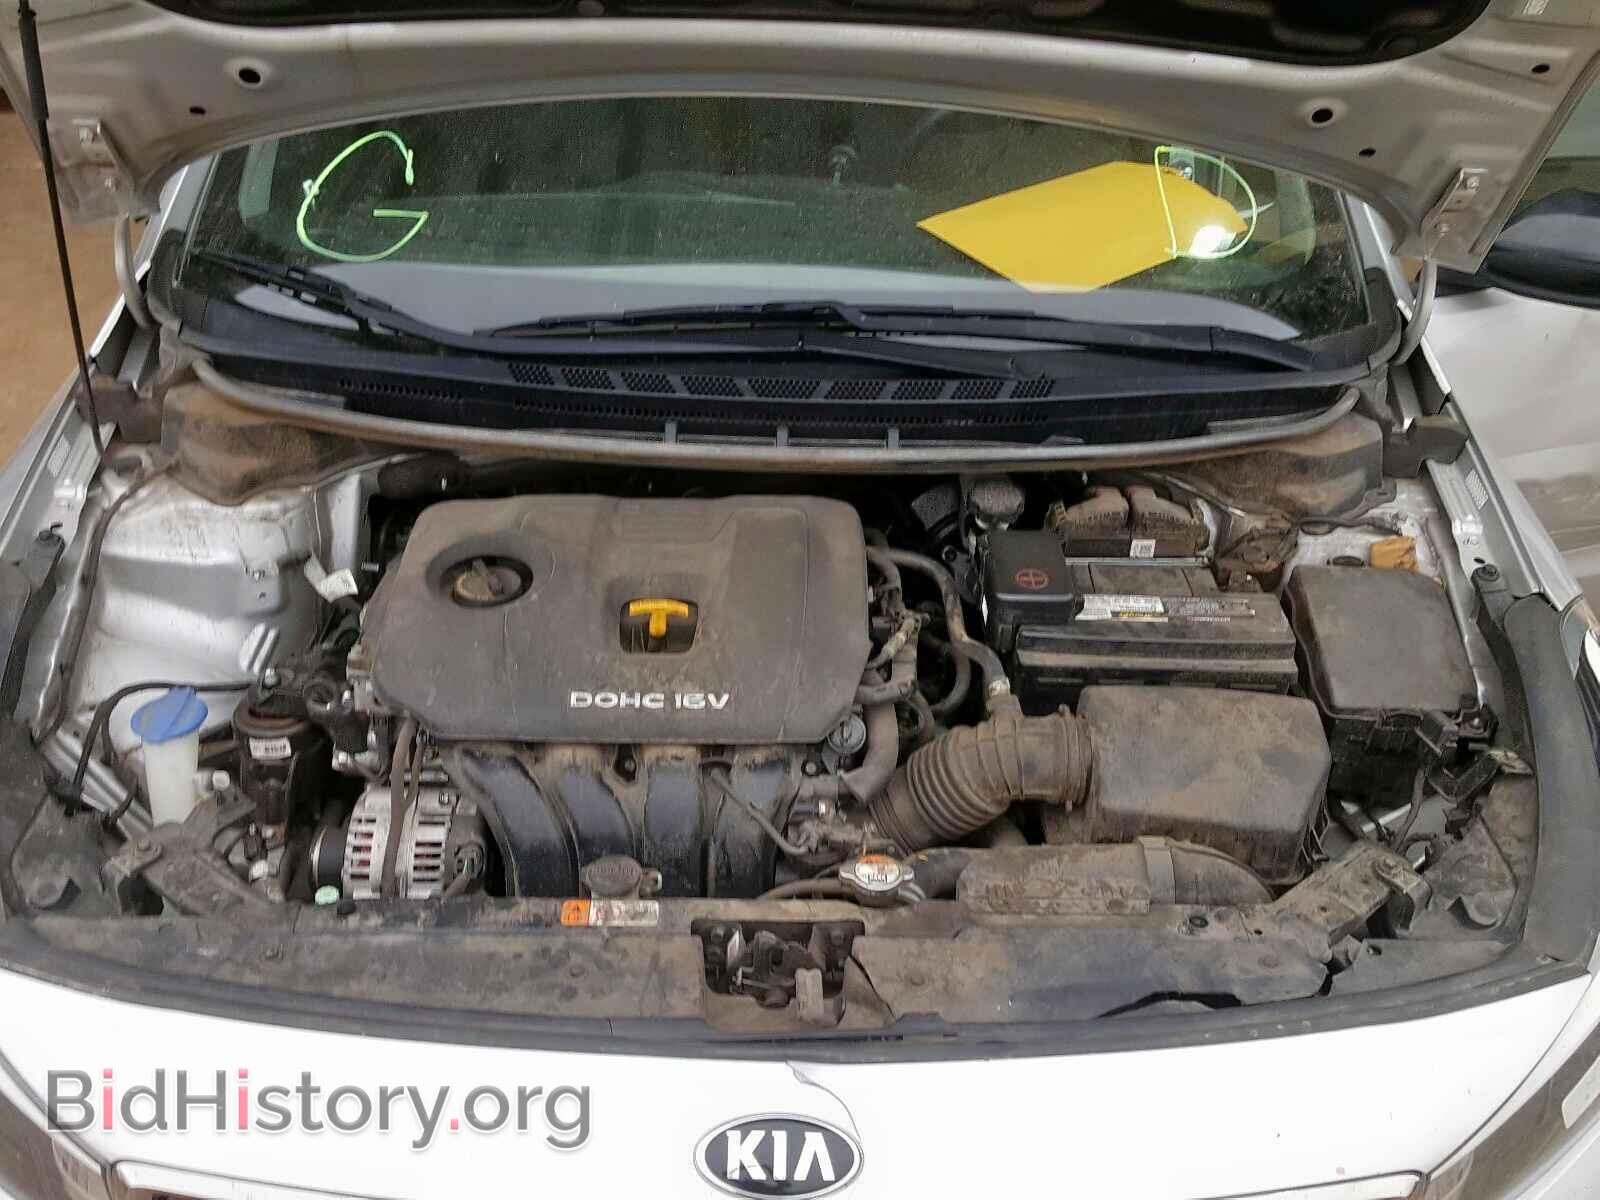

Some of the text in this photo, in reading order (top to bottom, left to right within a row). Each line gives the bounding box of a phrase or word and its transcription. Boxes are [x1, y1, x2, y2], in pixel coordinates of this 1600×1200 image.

[297, 130, 429, 262] G
[570, 691, 730, 710] DOHC 16V
[726, 1129, 836, 1182] KIA
